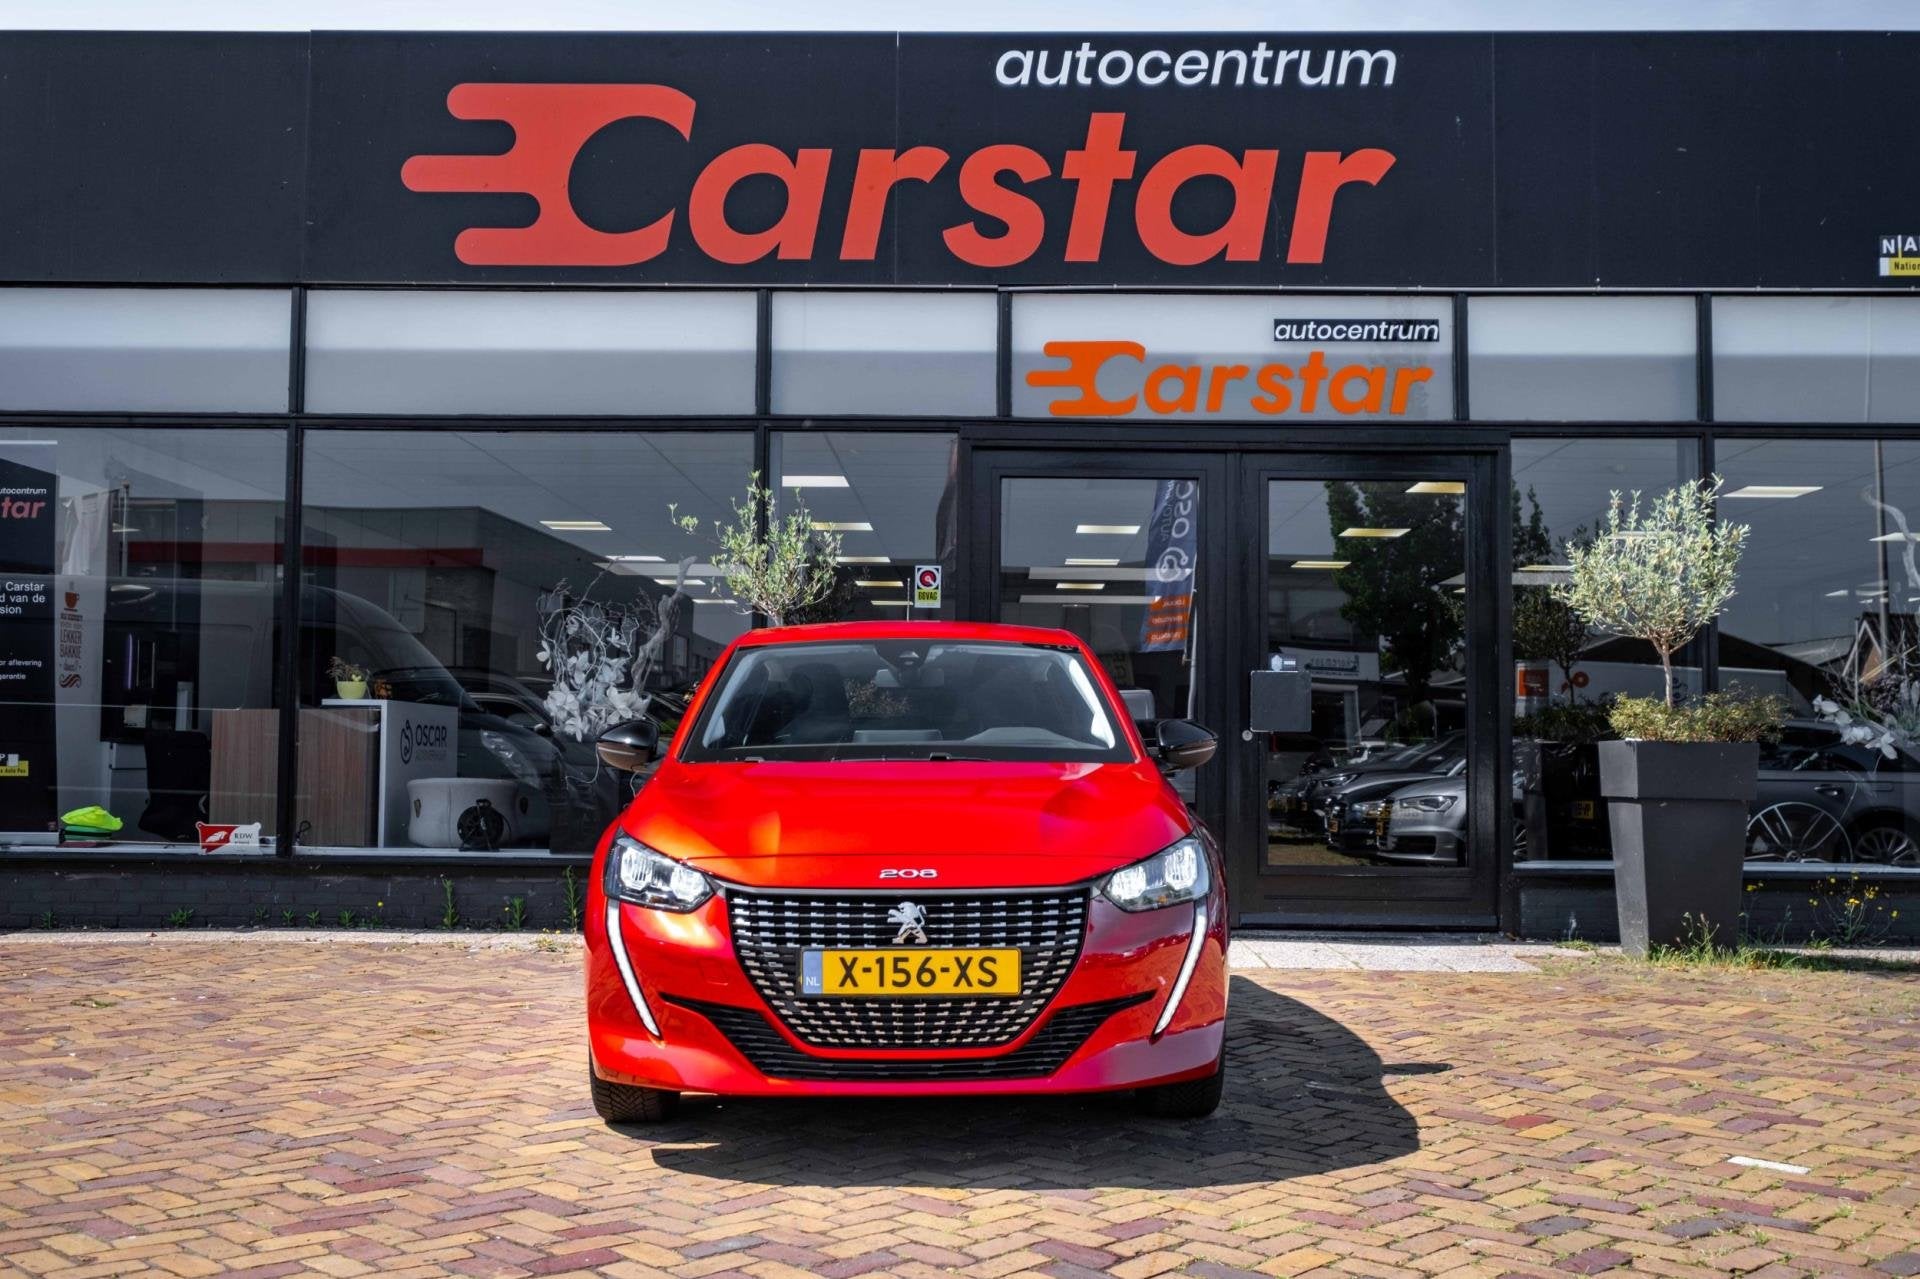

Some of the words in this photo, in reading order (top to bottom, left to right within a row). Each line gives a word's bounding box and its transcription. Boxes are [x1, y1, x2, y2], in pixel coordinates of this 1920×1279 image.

[996, 42, 1397, 86] autocentrum
[400, 82, 1396, 267] Carstar
[1275, 319, 1439, 341] autocentrum
[1026, 341, 1434, 416] Carstar
[1, 497, 46, 519] tar
[5, 581, 45, 592] Carstar
[9, 595, 29, 603] van
[32, 593, 46, 603] de
[415, 724, 448, 748] OSCAR
[879, 869, 938, 879] 208
[805, 976, 820, 986] NL
[838, 956, 998, 988] X-156-XS
